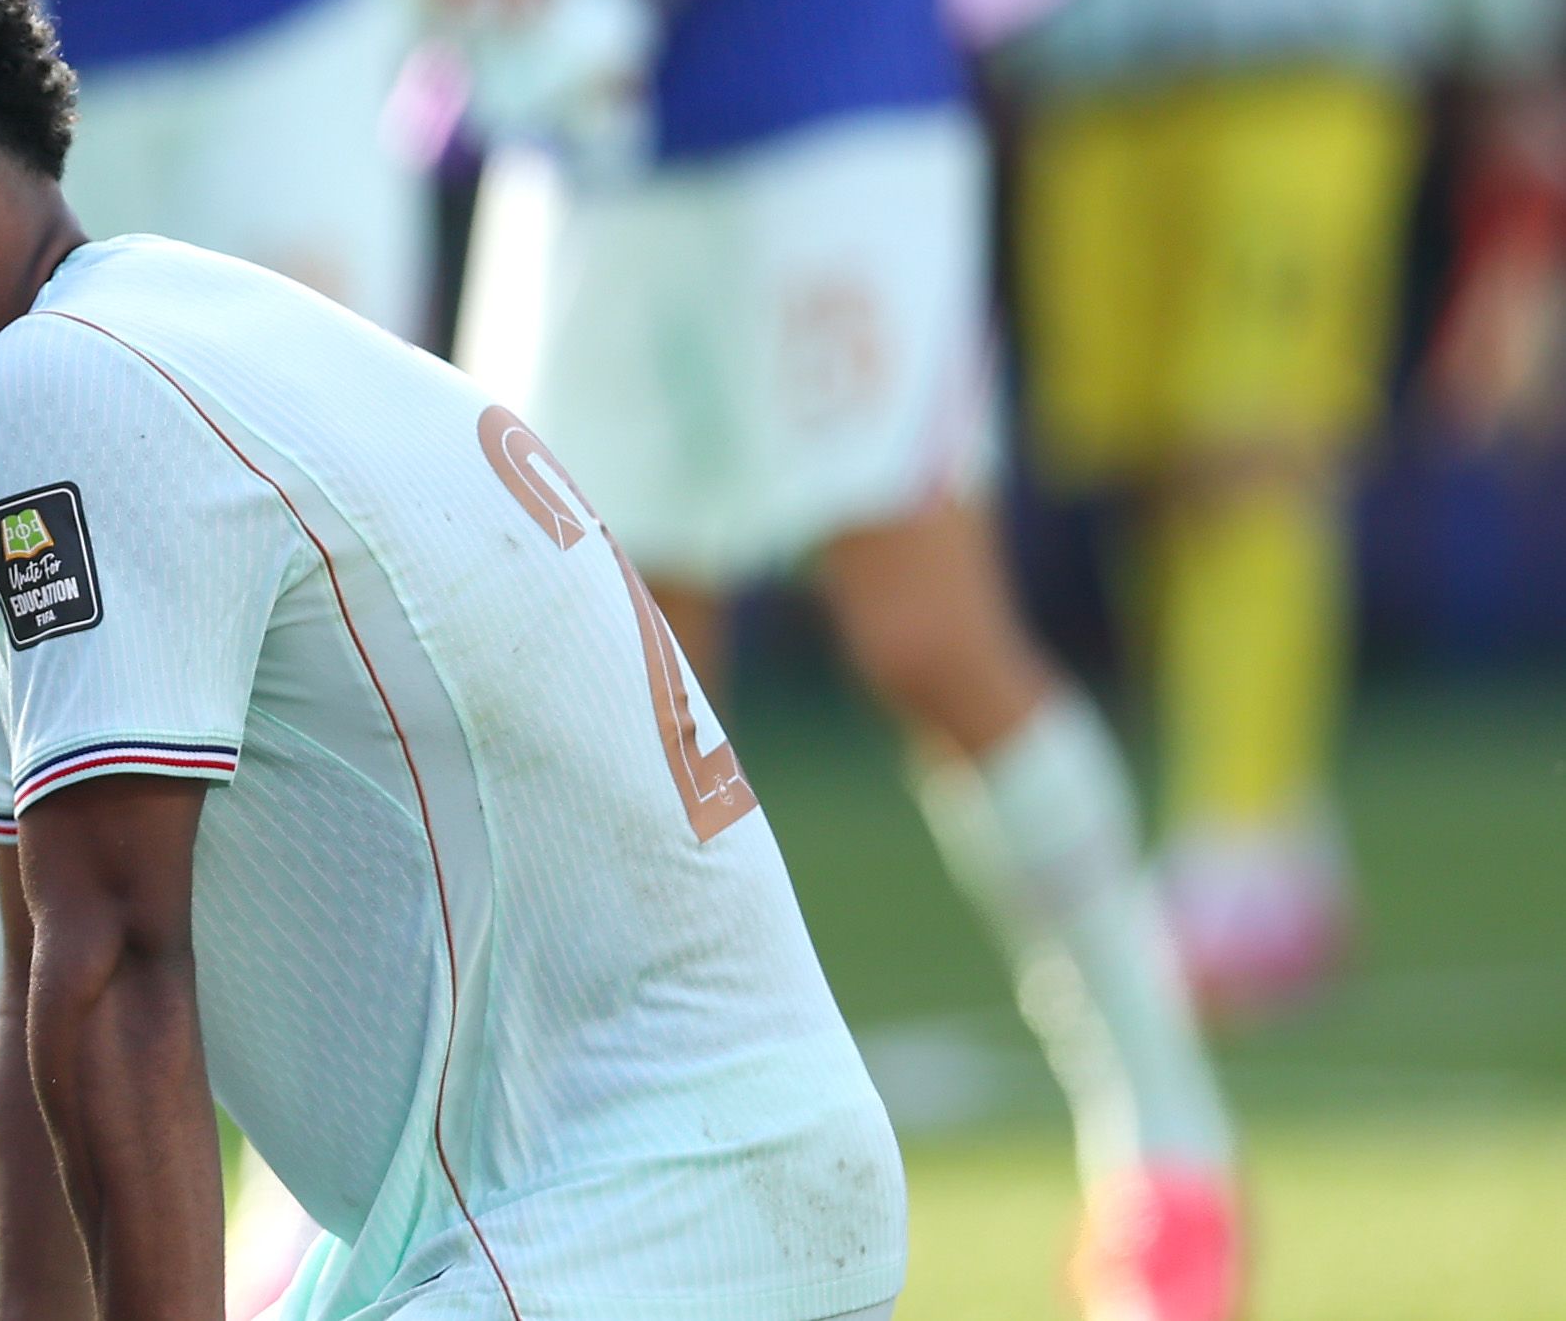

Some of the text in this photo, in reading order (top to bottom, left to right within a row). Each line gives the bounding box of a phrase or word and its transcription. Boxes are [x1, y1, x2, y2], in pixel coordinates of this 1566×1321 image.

[8, 552, 63, 591] Unite For
[9, 576, 80, 618] EDUCATION
[35, 609, 57, 627] FIFA
